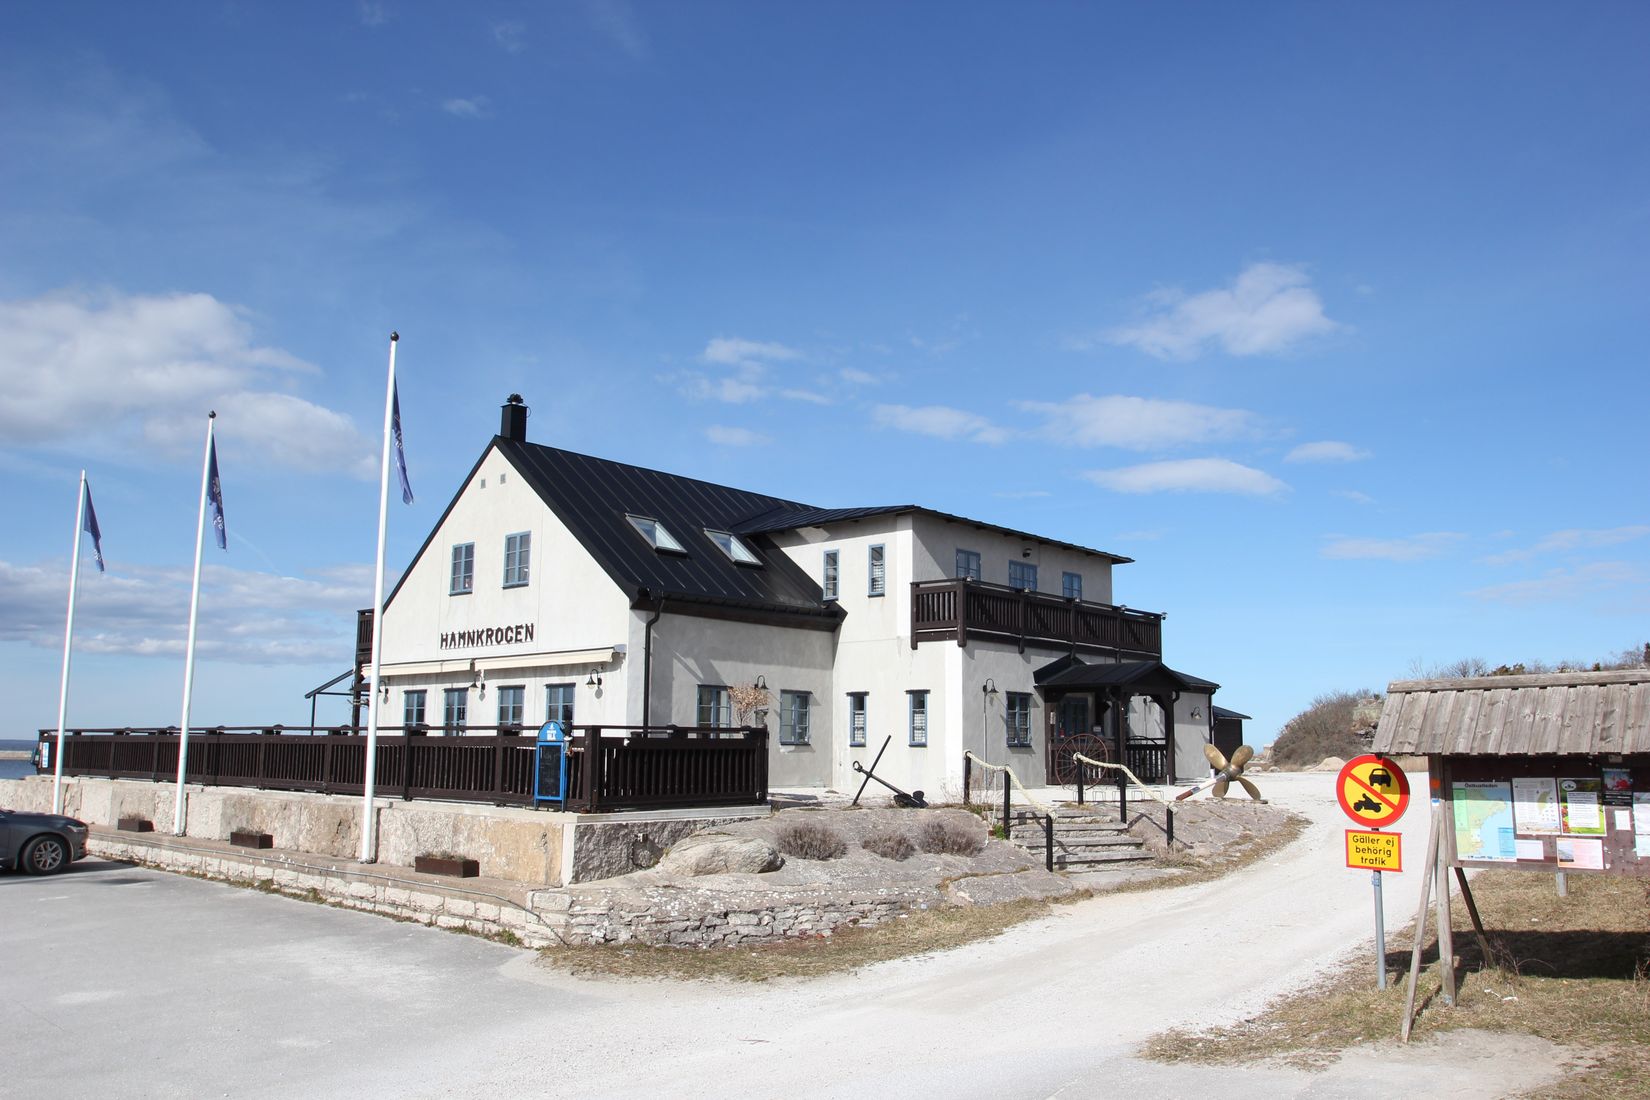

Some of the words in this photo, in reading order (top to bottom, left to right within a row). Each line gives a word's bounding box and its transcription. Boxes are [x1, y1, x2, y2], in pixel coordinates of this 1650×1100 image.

[440, 623, 534, 649] HAMNKROGEN
[1352, 835, 1380, 844] Gäller
[1386, 837, 1395, 847] ej
[1355, 846, 1392, 857] behörig
[1361, 857, 1386, 865] trafik
